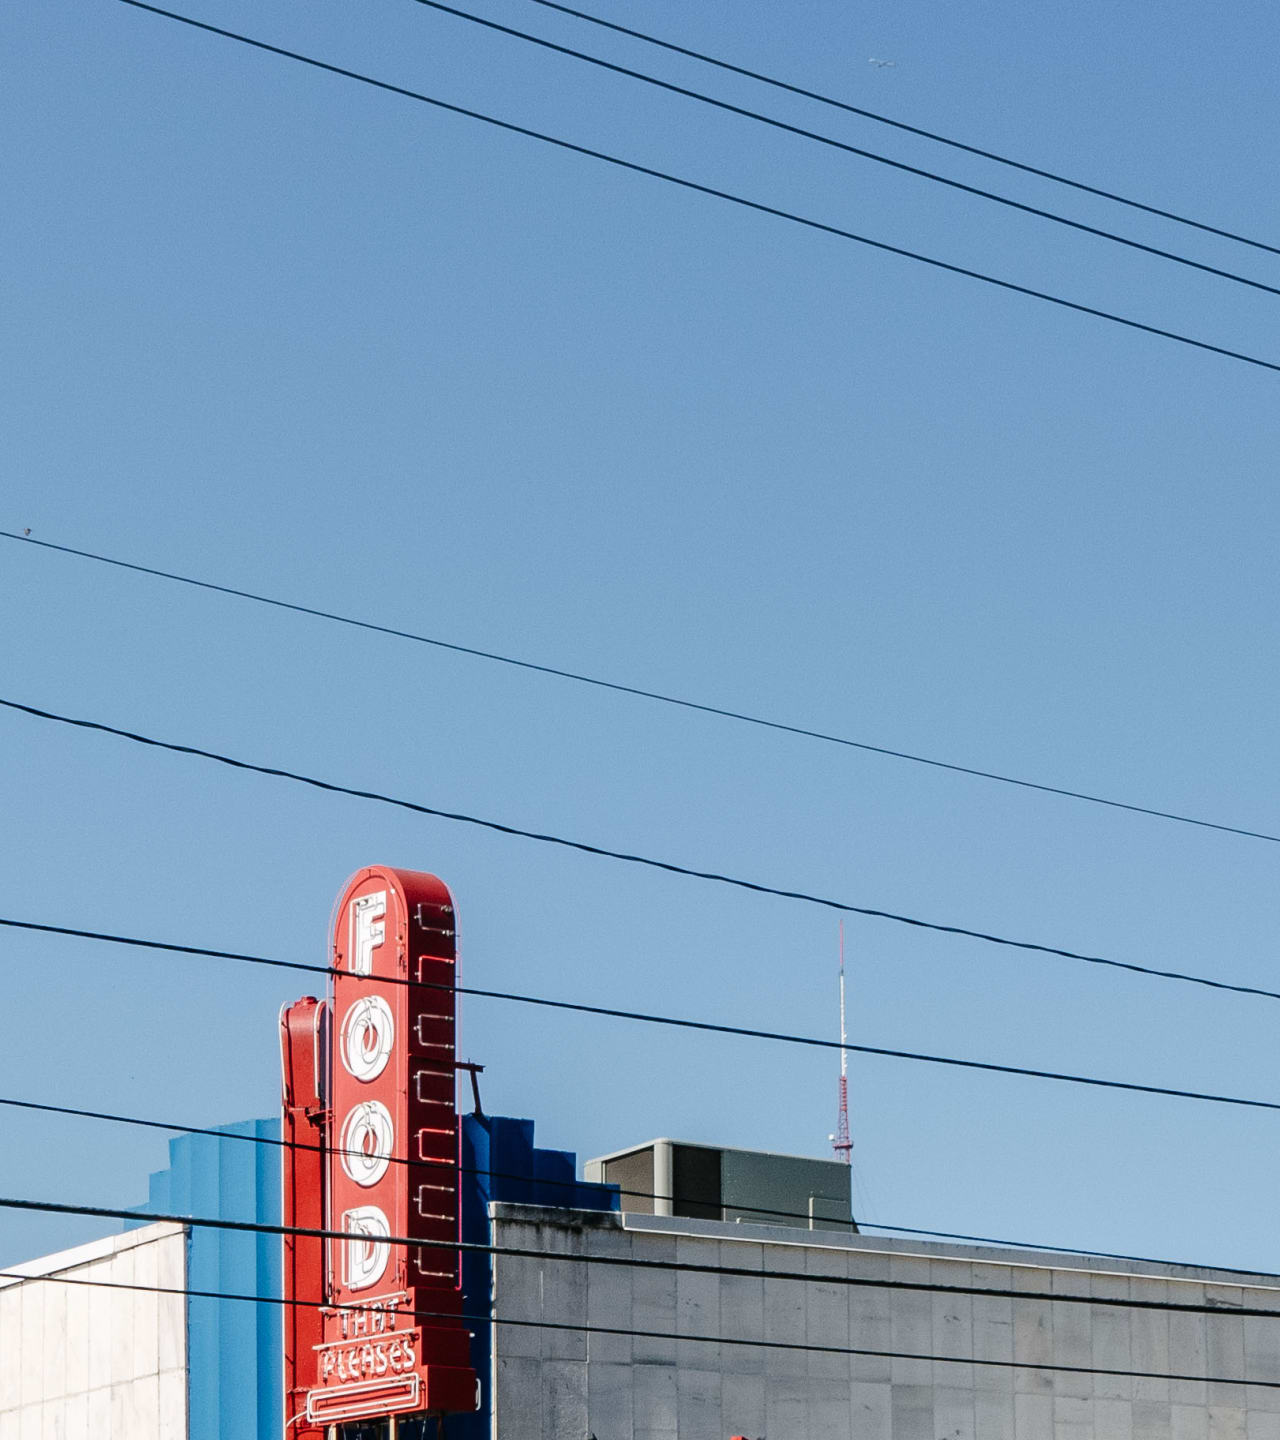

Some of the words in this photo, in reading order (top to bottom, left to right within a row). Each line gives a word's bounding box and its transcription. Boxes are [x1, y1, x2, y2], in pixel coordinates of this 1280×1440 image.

[339, 890, 396, 1291] FOOD
[339, 1298, 399, 1338] THAT
[322, 1338, 416, 1381] PLEASES
